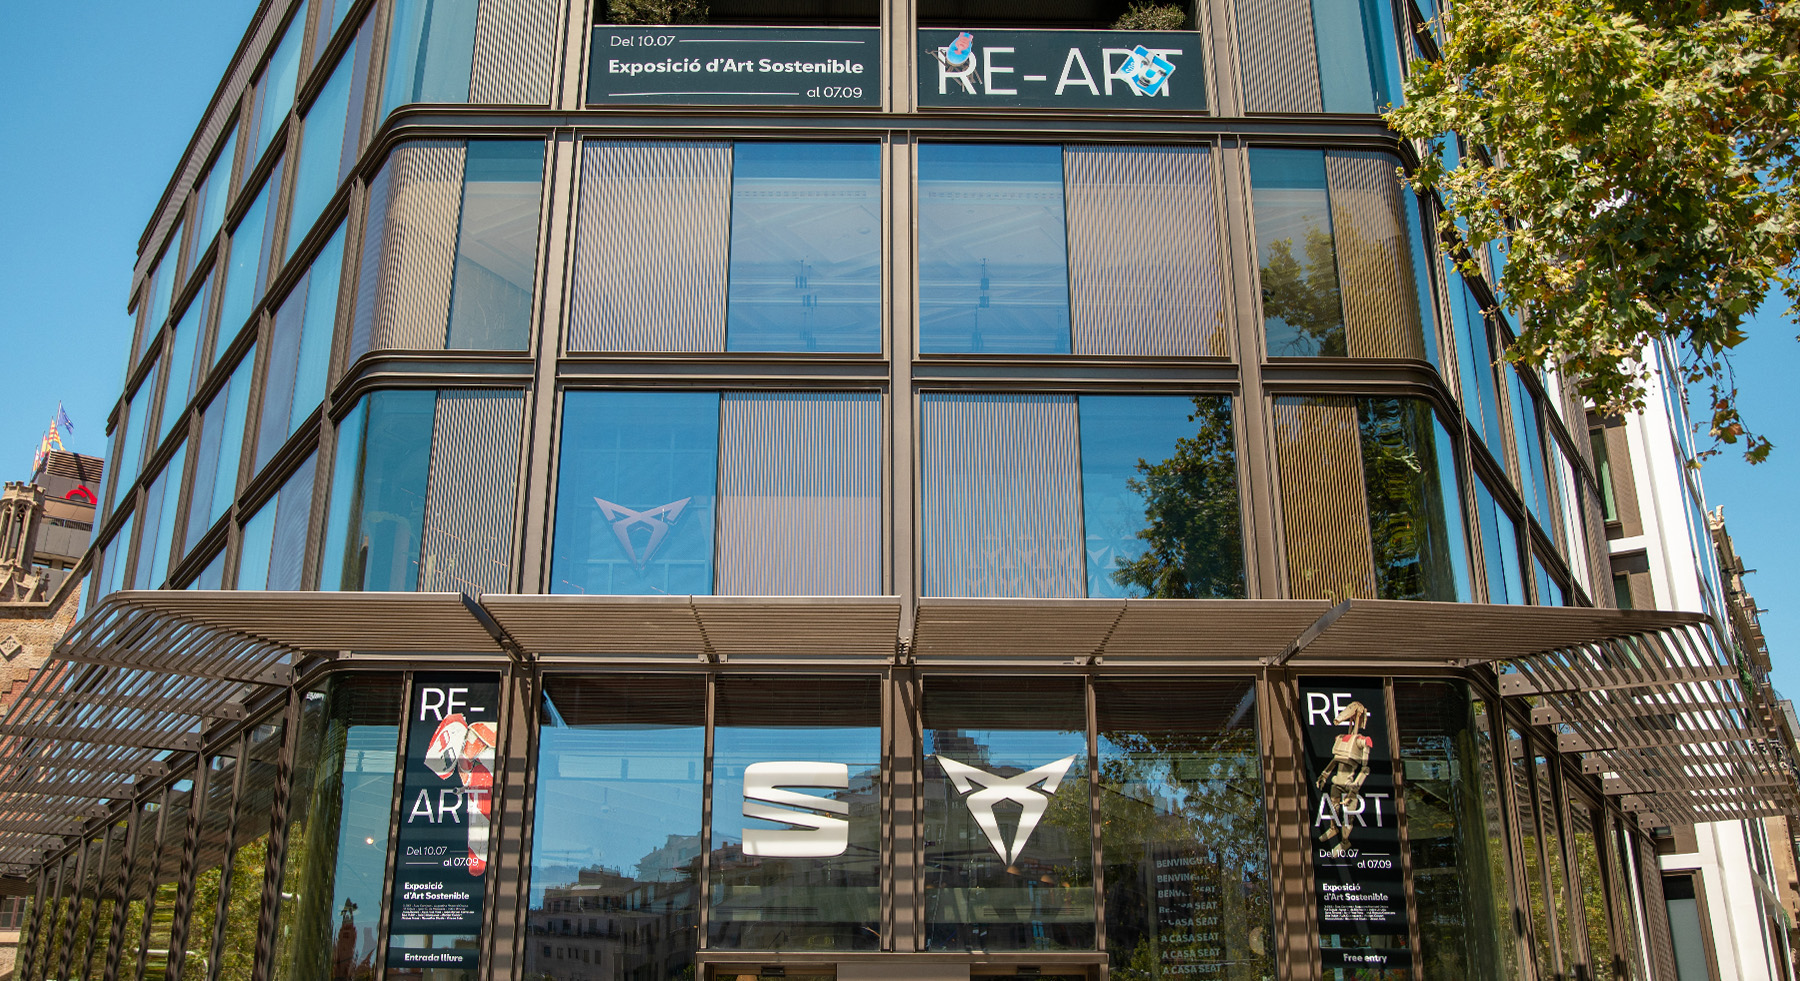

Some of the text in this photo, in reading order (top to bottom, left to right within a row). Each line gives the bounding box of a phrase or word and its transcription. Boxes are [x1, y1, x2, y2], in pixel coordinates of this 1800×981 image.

[610, 35, 676, 47] Del 10.07
[608, 58, 864, 76] Exposició d'Art Sostenible
[937, 46, 1183, 96] RE-ART
[806, 86, 862, 98] al 07.09
[420, 688, 485, 721] RE-
[408, 788, 488, 824] ART
[1314, 792, 1389, 827] ART
[406, 846, 448, 856] Del 10.07
[1320, 849, 1359, 858] Del 10.07
[443, 858, 478, 866] al 07.09
[1156, 856, 1213, 868] BENVINGUT
[1357, 860, 1392, 868] al 07.09
[404, 882, 444, 890] Exposició
[1322, 882, 1360, 892] Exposició
[404, 892, 470, 900] d'Art Sostenible
[1344, 892, 1388, 901] Sostenible
[1194, 902, 1217, 910] SEAT
[1196, 916, 1218, 926] SEAT
[1169, 934, 1194, 942] CASA
[1196, 932, 1218, 941] SEAT
[404, 953, 463, 962] Entrada lliure
[1170, 950, 1196, 959] CASA
[1197, 948, 1220, 957] SEAT
[1343, 954, 1388, 964] Free entry
[1171, 964, 1197, 974] CASA
[1198, 964, 1220, 973] SEAT
